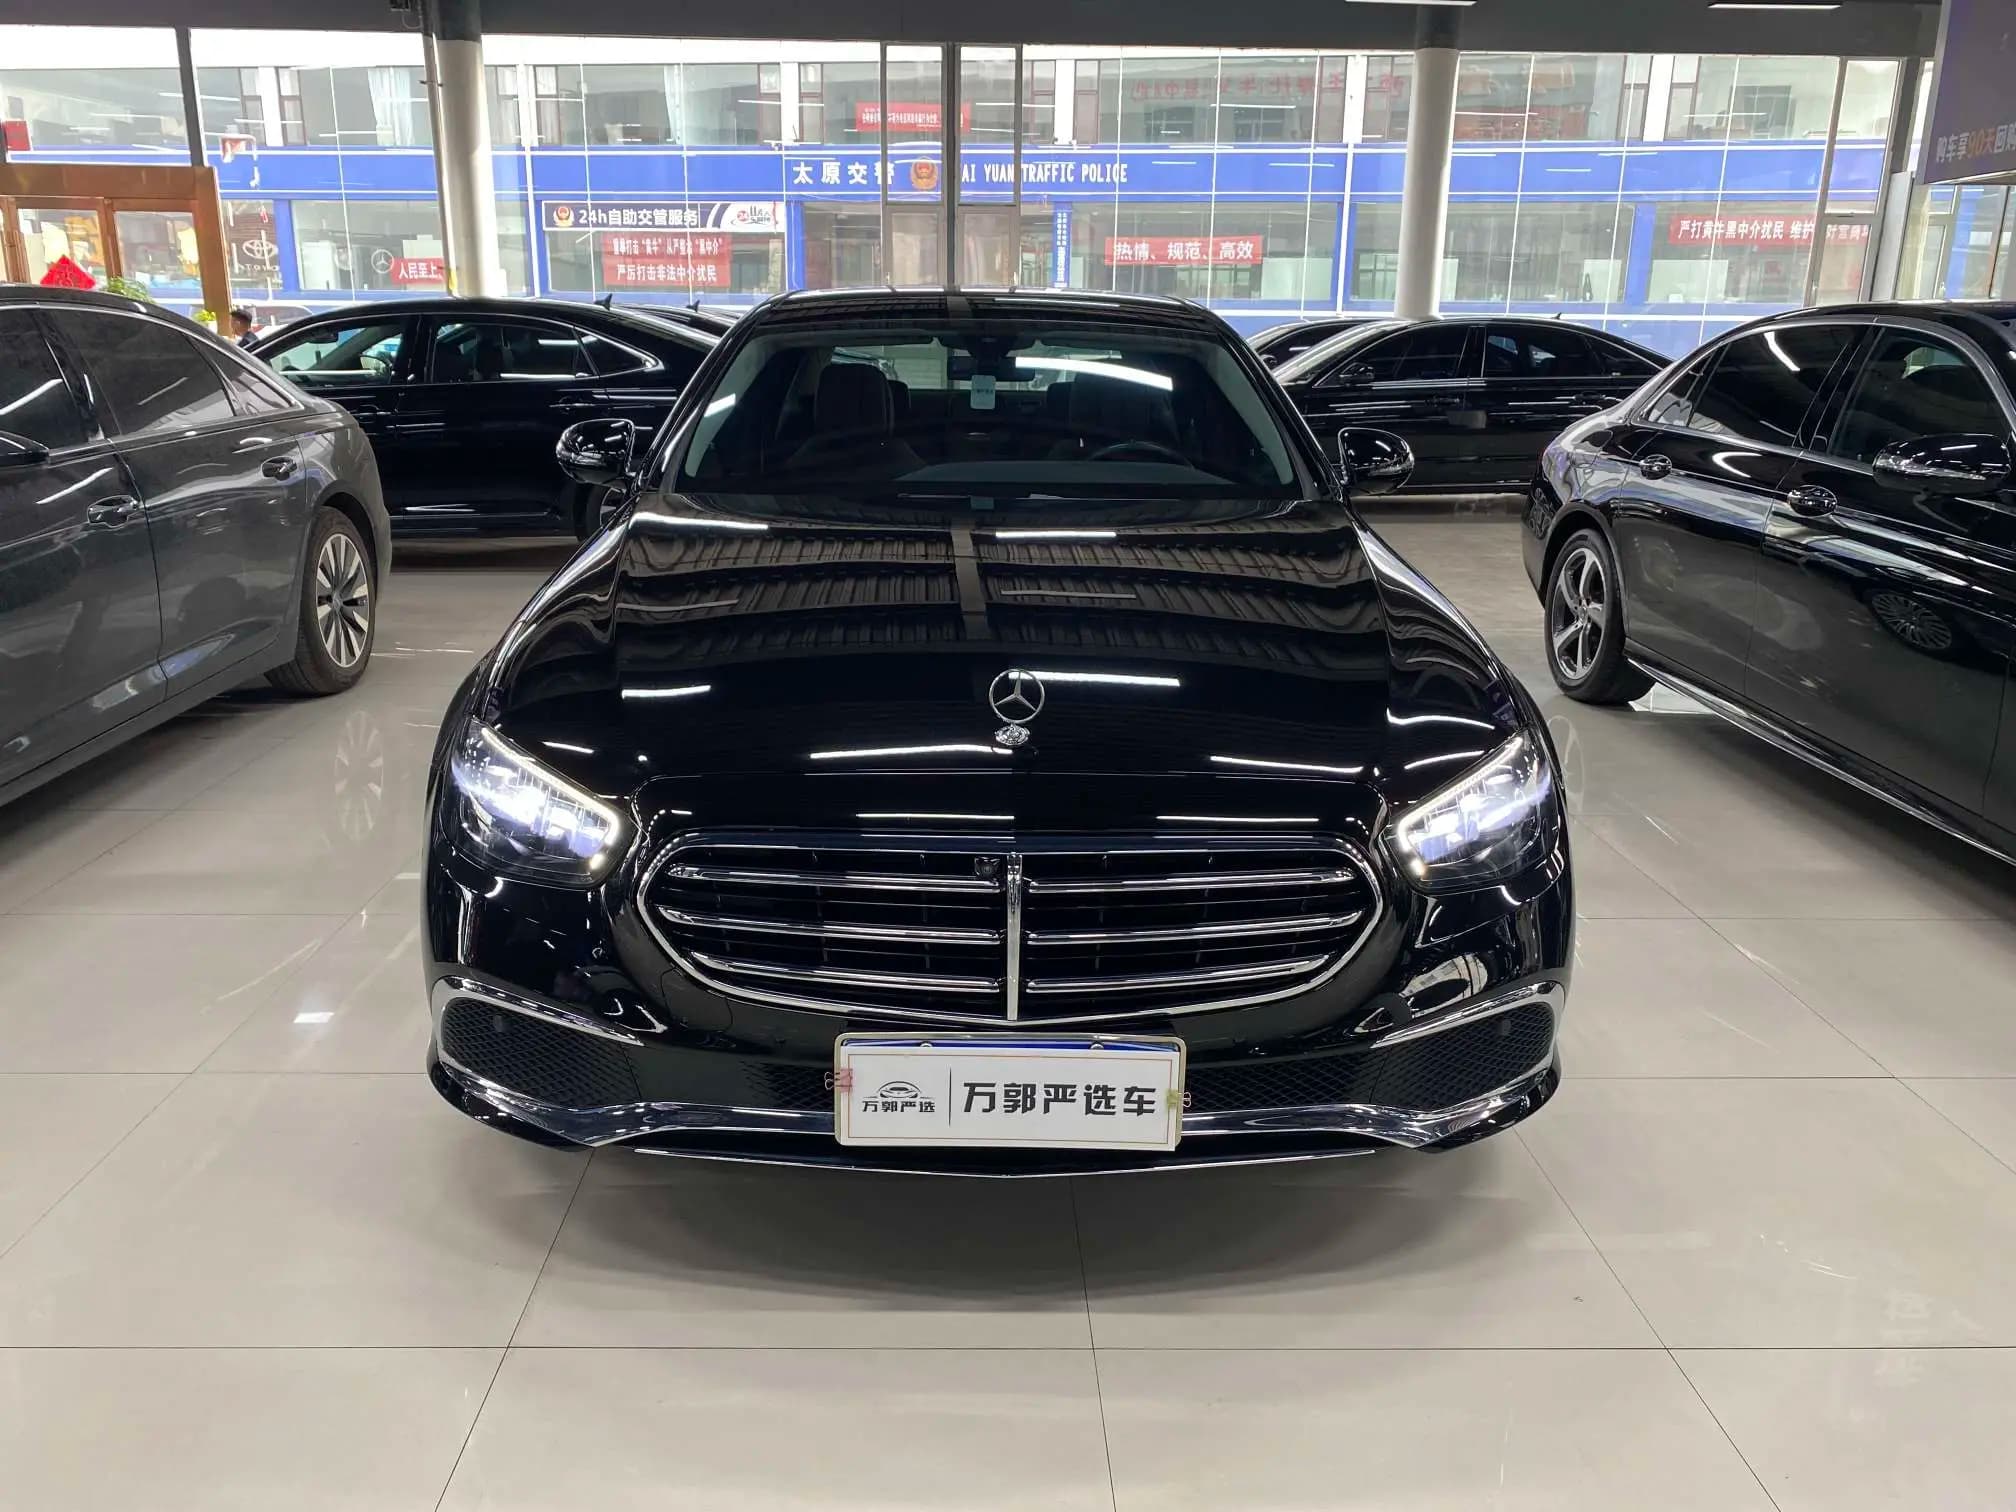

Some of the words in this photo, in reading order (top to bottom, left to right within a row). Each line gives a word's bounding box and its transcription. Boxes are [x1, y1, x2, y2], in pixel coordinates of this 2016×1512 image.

[793, 161, 895, 184] 太原交警
[984, 163, 1014, 183] YUAN
[1022, 163, 1075, 183] TRAFFIC
[1081, 163, 1128, 183] POLICE
[579, 208, 698, 226] 24h自助交管服务
[617, 264, 718, 281] 严厉打击非法中介扰民
[862, 1100, 936, 1113] 万郭严选
[963, 1082, 1156, 1116] 万郭严选车
